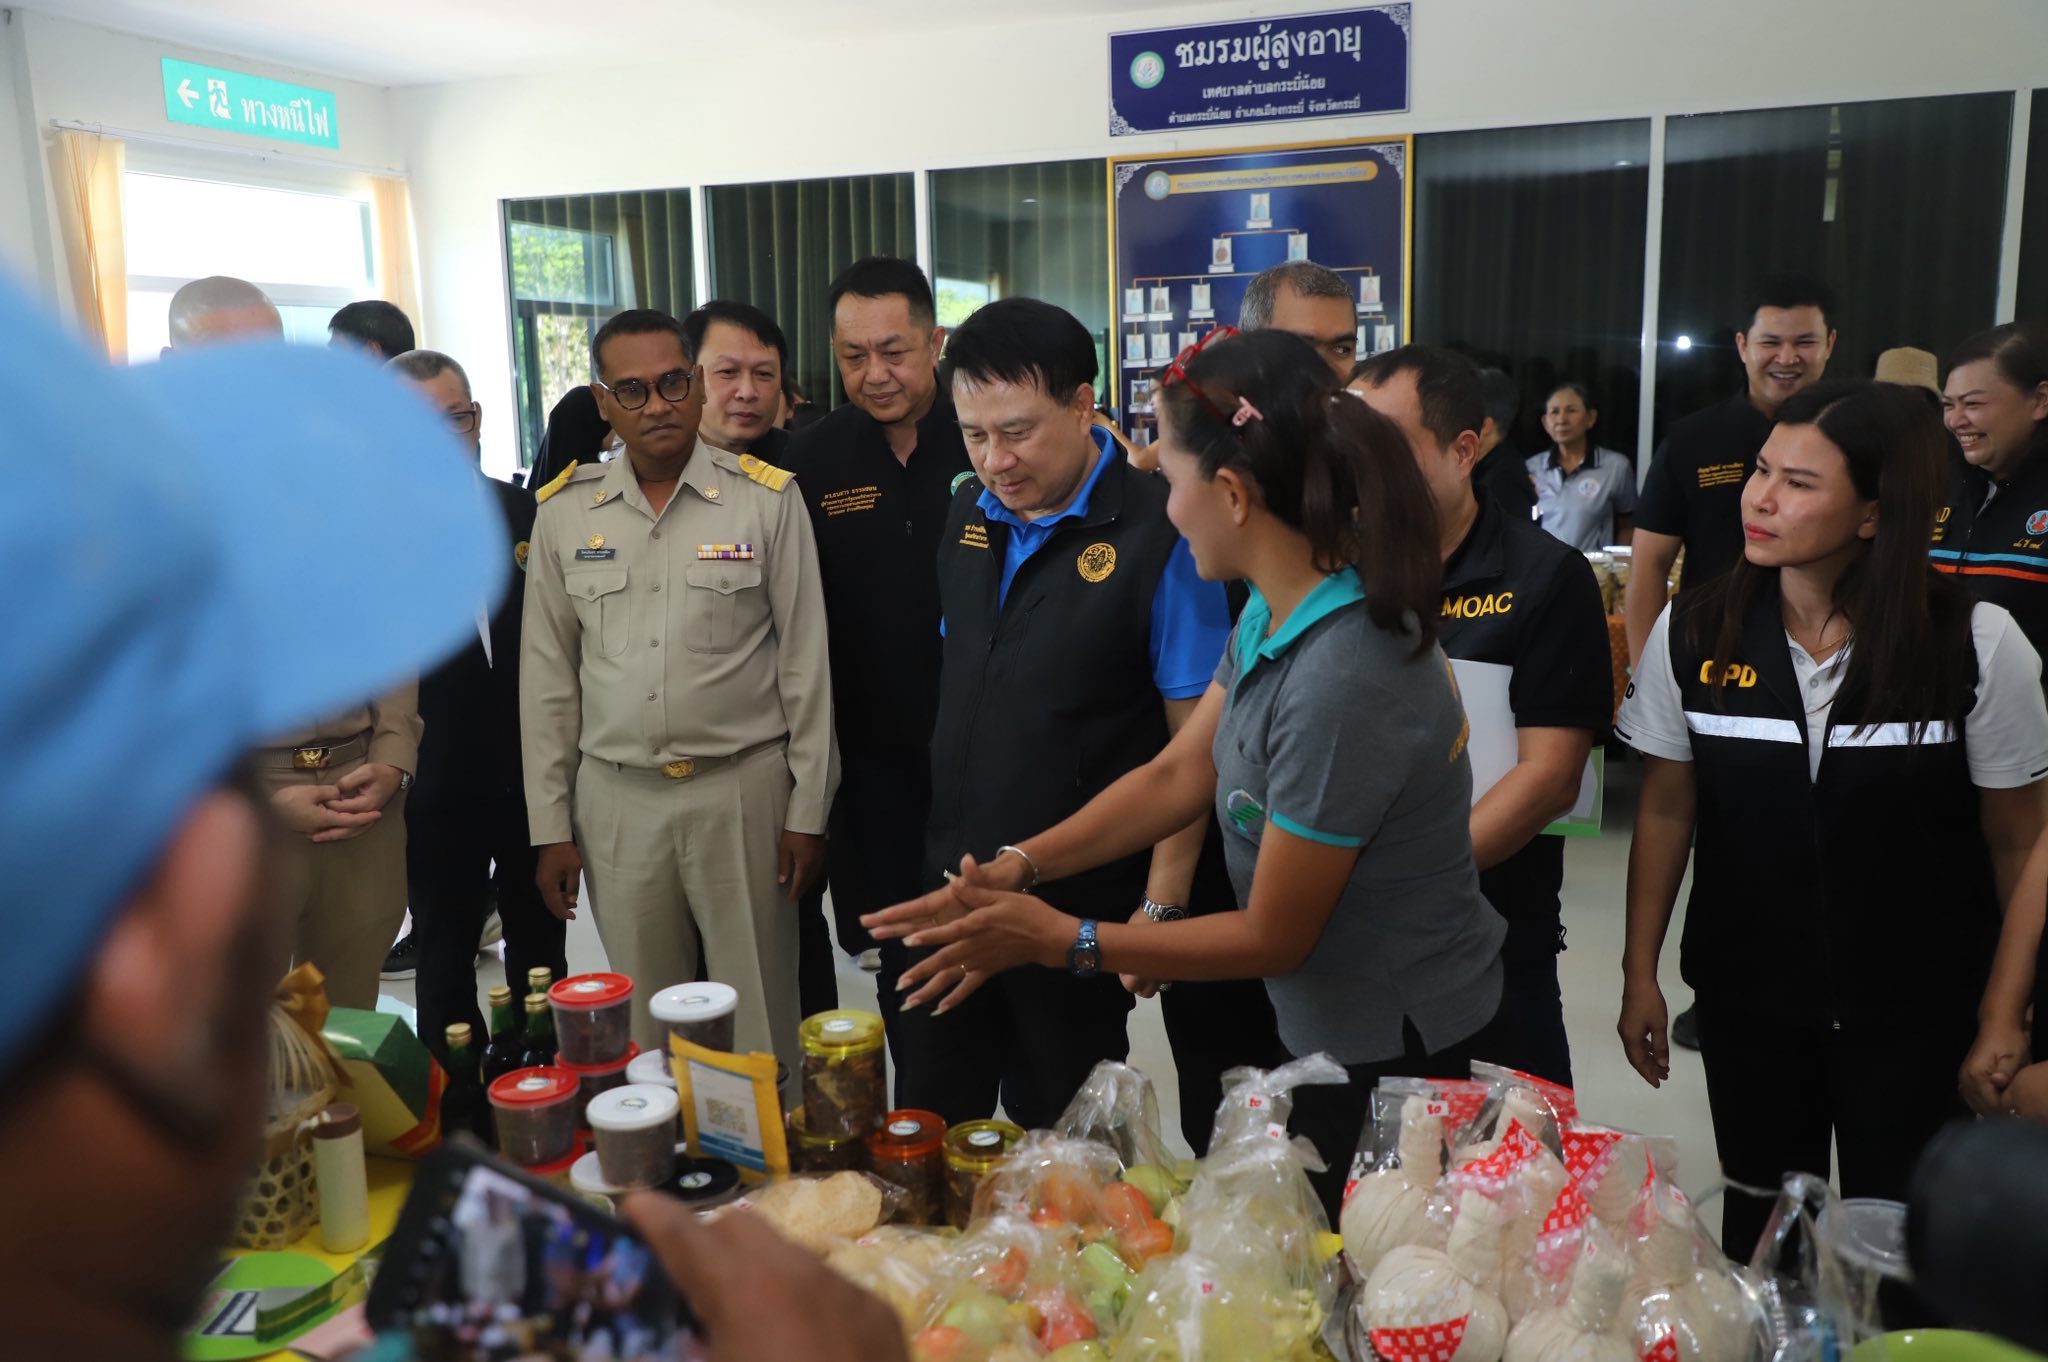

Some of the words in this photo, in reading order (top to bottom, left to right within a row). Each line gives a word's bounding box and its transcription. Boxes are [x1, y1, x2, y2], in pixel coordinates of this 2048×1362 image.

[1175, 23, 1361, 71] ชมรมผู้สูงอายุ
[1202, 72, 1326, 99] เทศบาลตำบลกระบี่น้อย
[240, 97, 329, 137] ทางหนีไฟ
[1168, 106, 1231, 124] ตำบลกระบี่น้อย
[1308, 93, 1361, 113] จังหวัดกระบี่
[1441, 591, 1514, 619] MOAC
